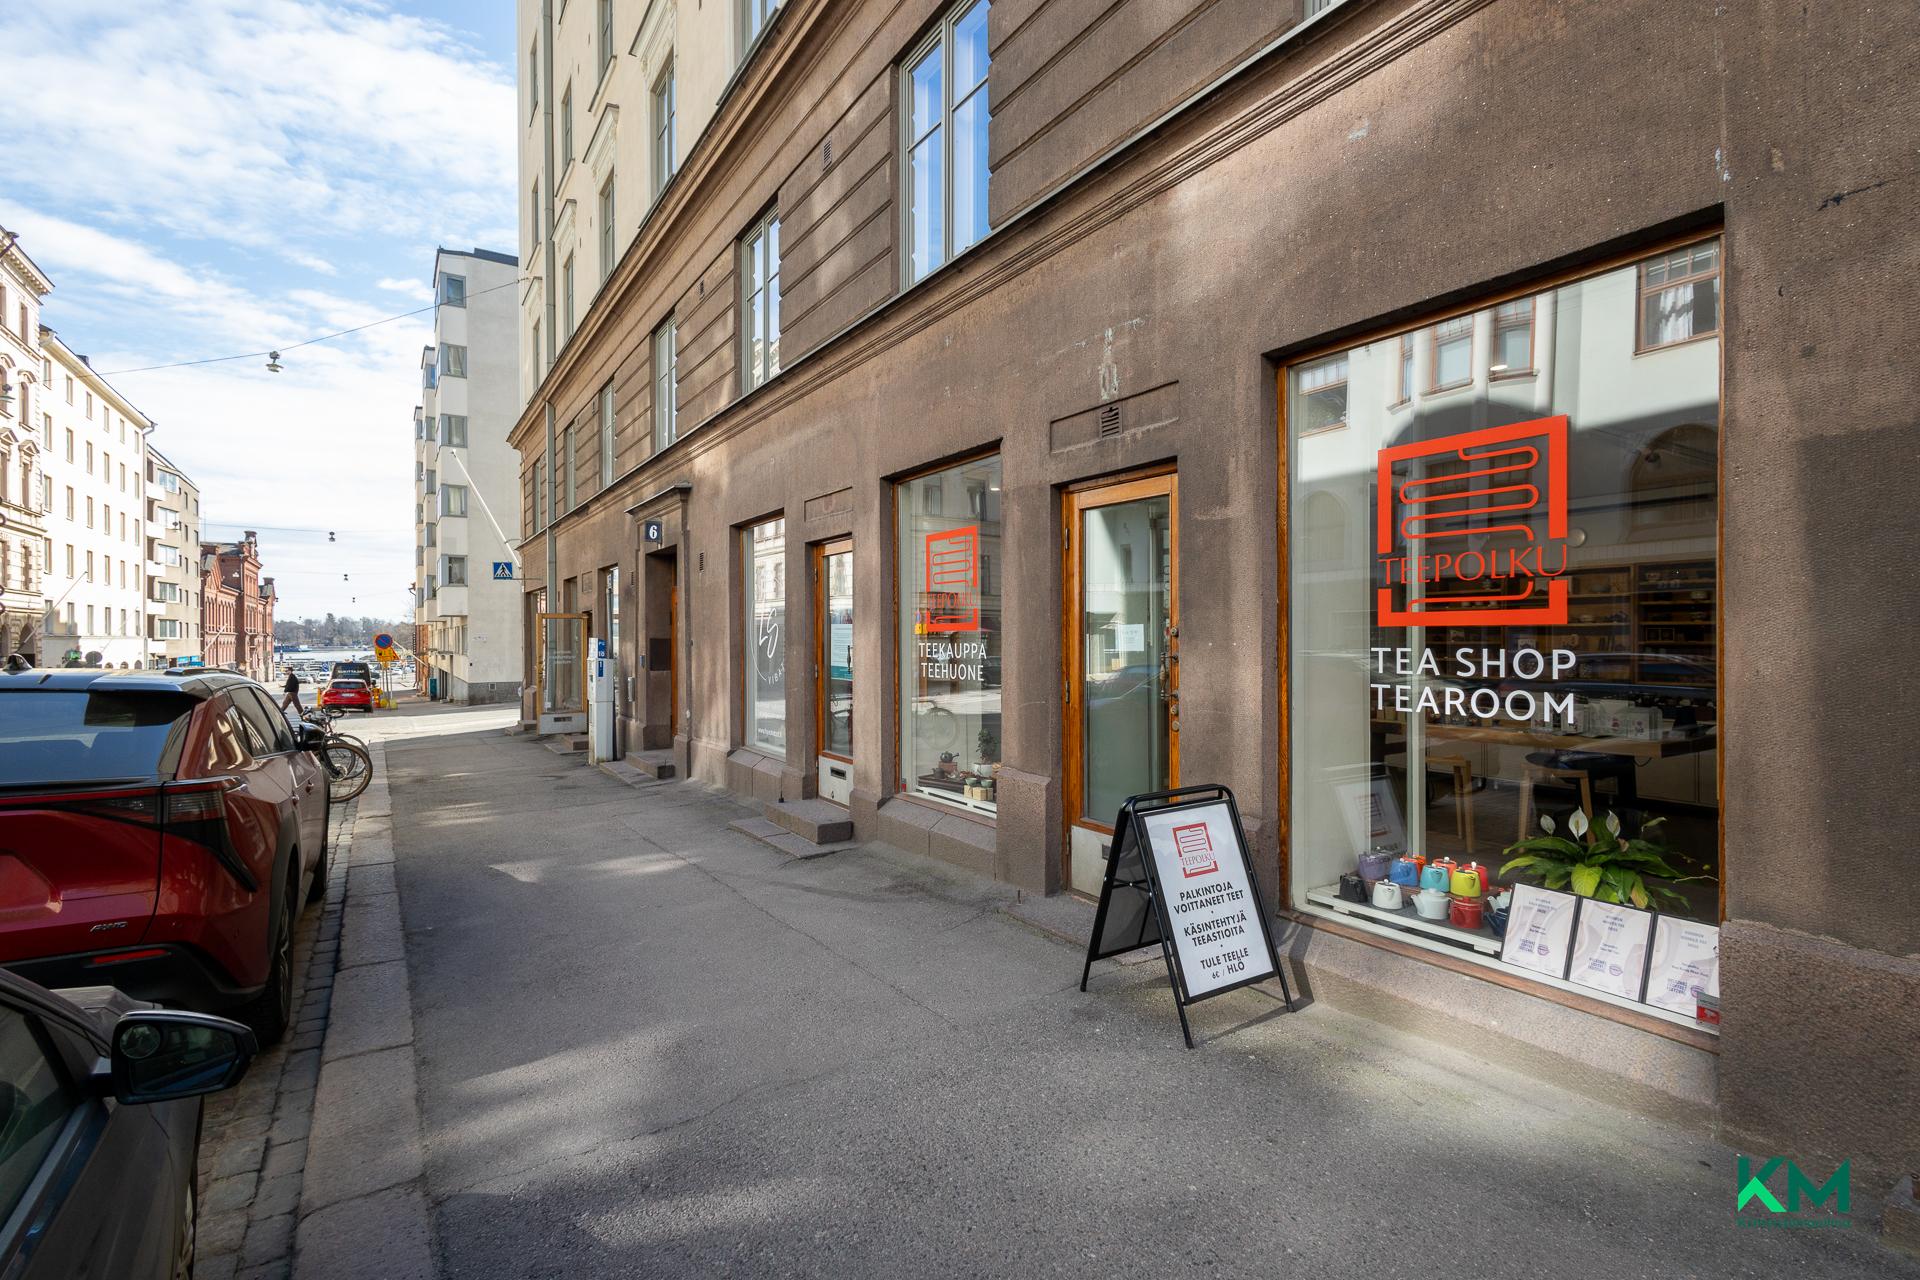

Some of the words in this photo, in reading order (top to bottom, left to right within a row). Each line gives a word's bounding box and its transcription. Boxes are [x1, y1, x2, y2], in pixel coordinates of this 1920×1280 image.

[649, 525, 658, 540] 6
[1378, 544, 1567, 584] TEEPOLKU
[918, 642, 987, 660] TEEKAUPPA
[920, 662, 985, 682] TEEHUONE
[1371, 647, 1440, 676] TEA
[1455, 647, 1577, 680] SHOP
[1371, 683, 1575, 724] TEAROOM
[1173, 894, 1226, 915] VOITTANEET
[1226, 889, 1244, 902] TEET
[1180, 881, 1233, 902] PALKINTOJA
[1183, 909, 1247, 937] KÄSINTEHTYJÄ
[1192, 925, 1245, 947] TEEASTIOITA
[1200, 955, 1222, 970] TULE
[1222, 947, 1249, 963] TEELLE
[1227, 958, 1245, 975] HLÖ
